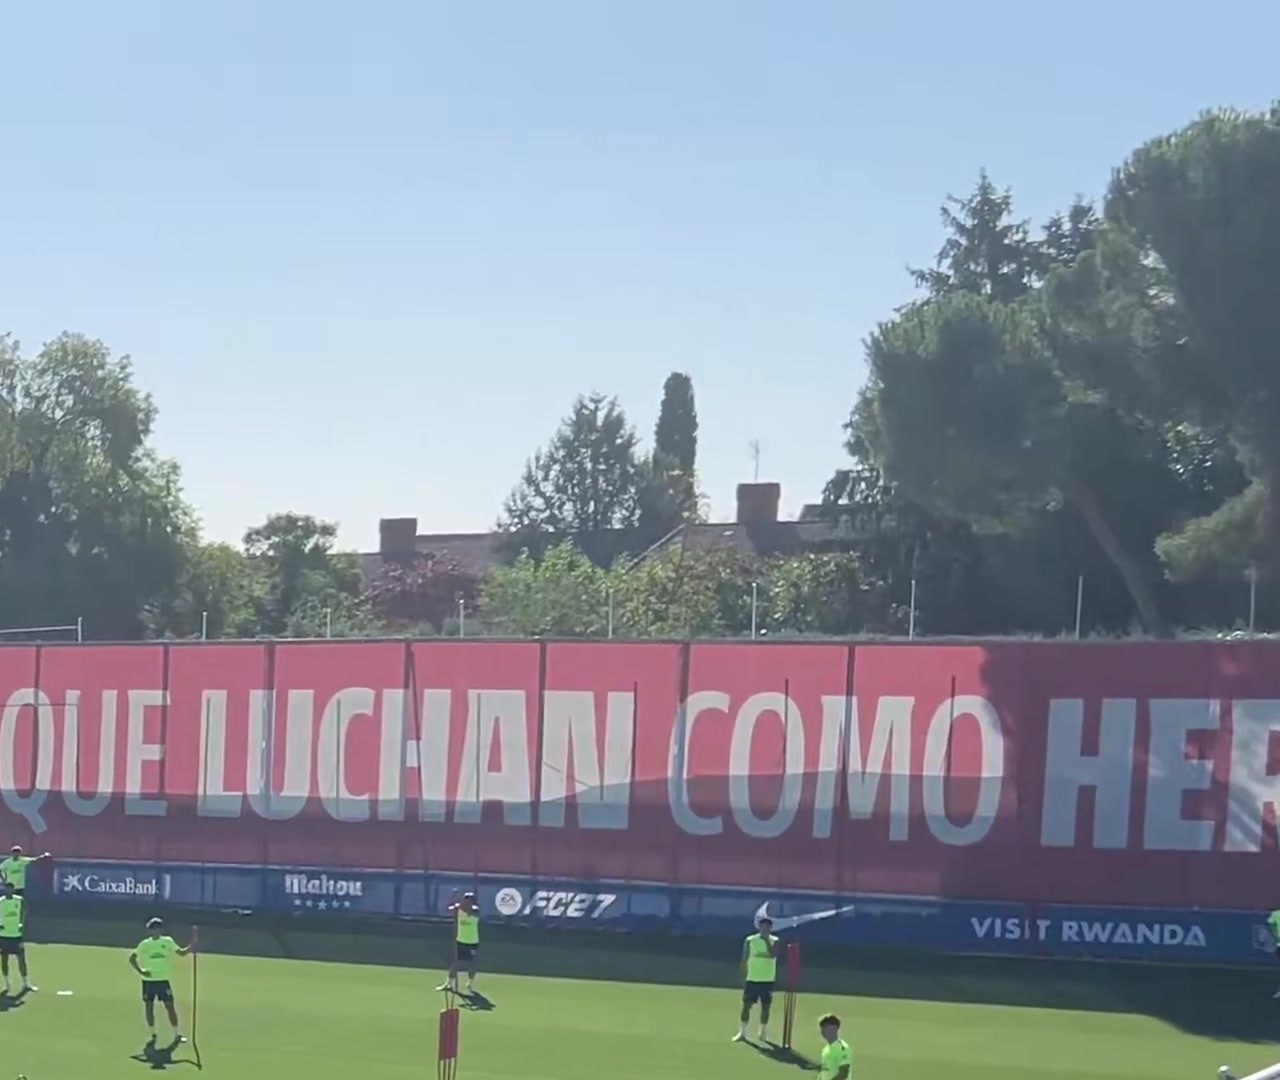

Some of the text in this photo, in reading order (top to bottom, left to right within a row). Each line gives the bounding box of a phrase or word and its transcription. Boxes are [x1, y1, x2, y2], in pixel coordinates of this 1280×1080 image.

[196, 686, 636, 830] LUCHAN
[667, 690, 1005, 846] COMO
[84, 875, 160, 896] CaixaBank
[285, 873, 363, 897] Mahou
[970, 917, 1207, 947] VISIT RWANDA
